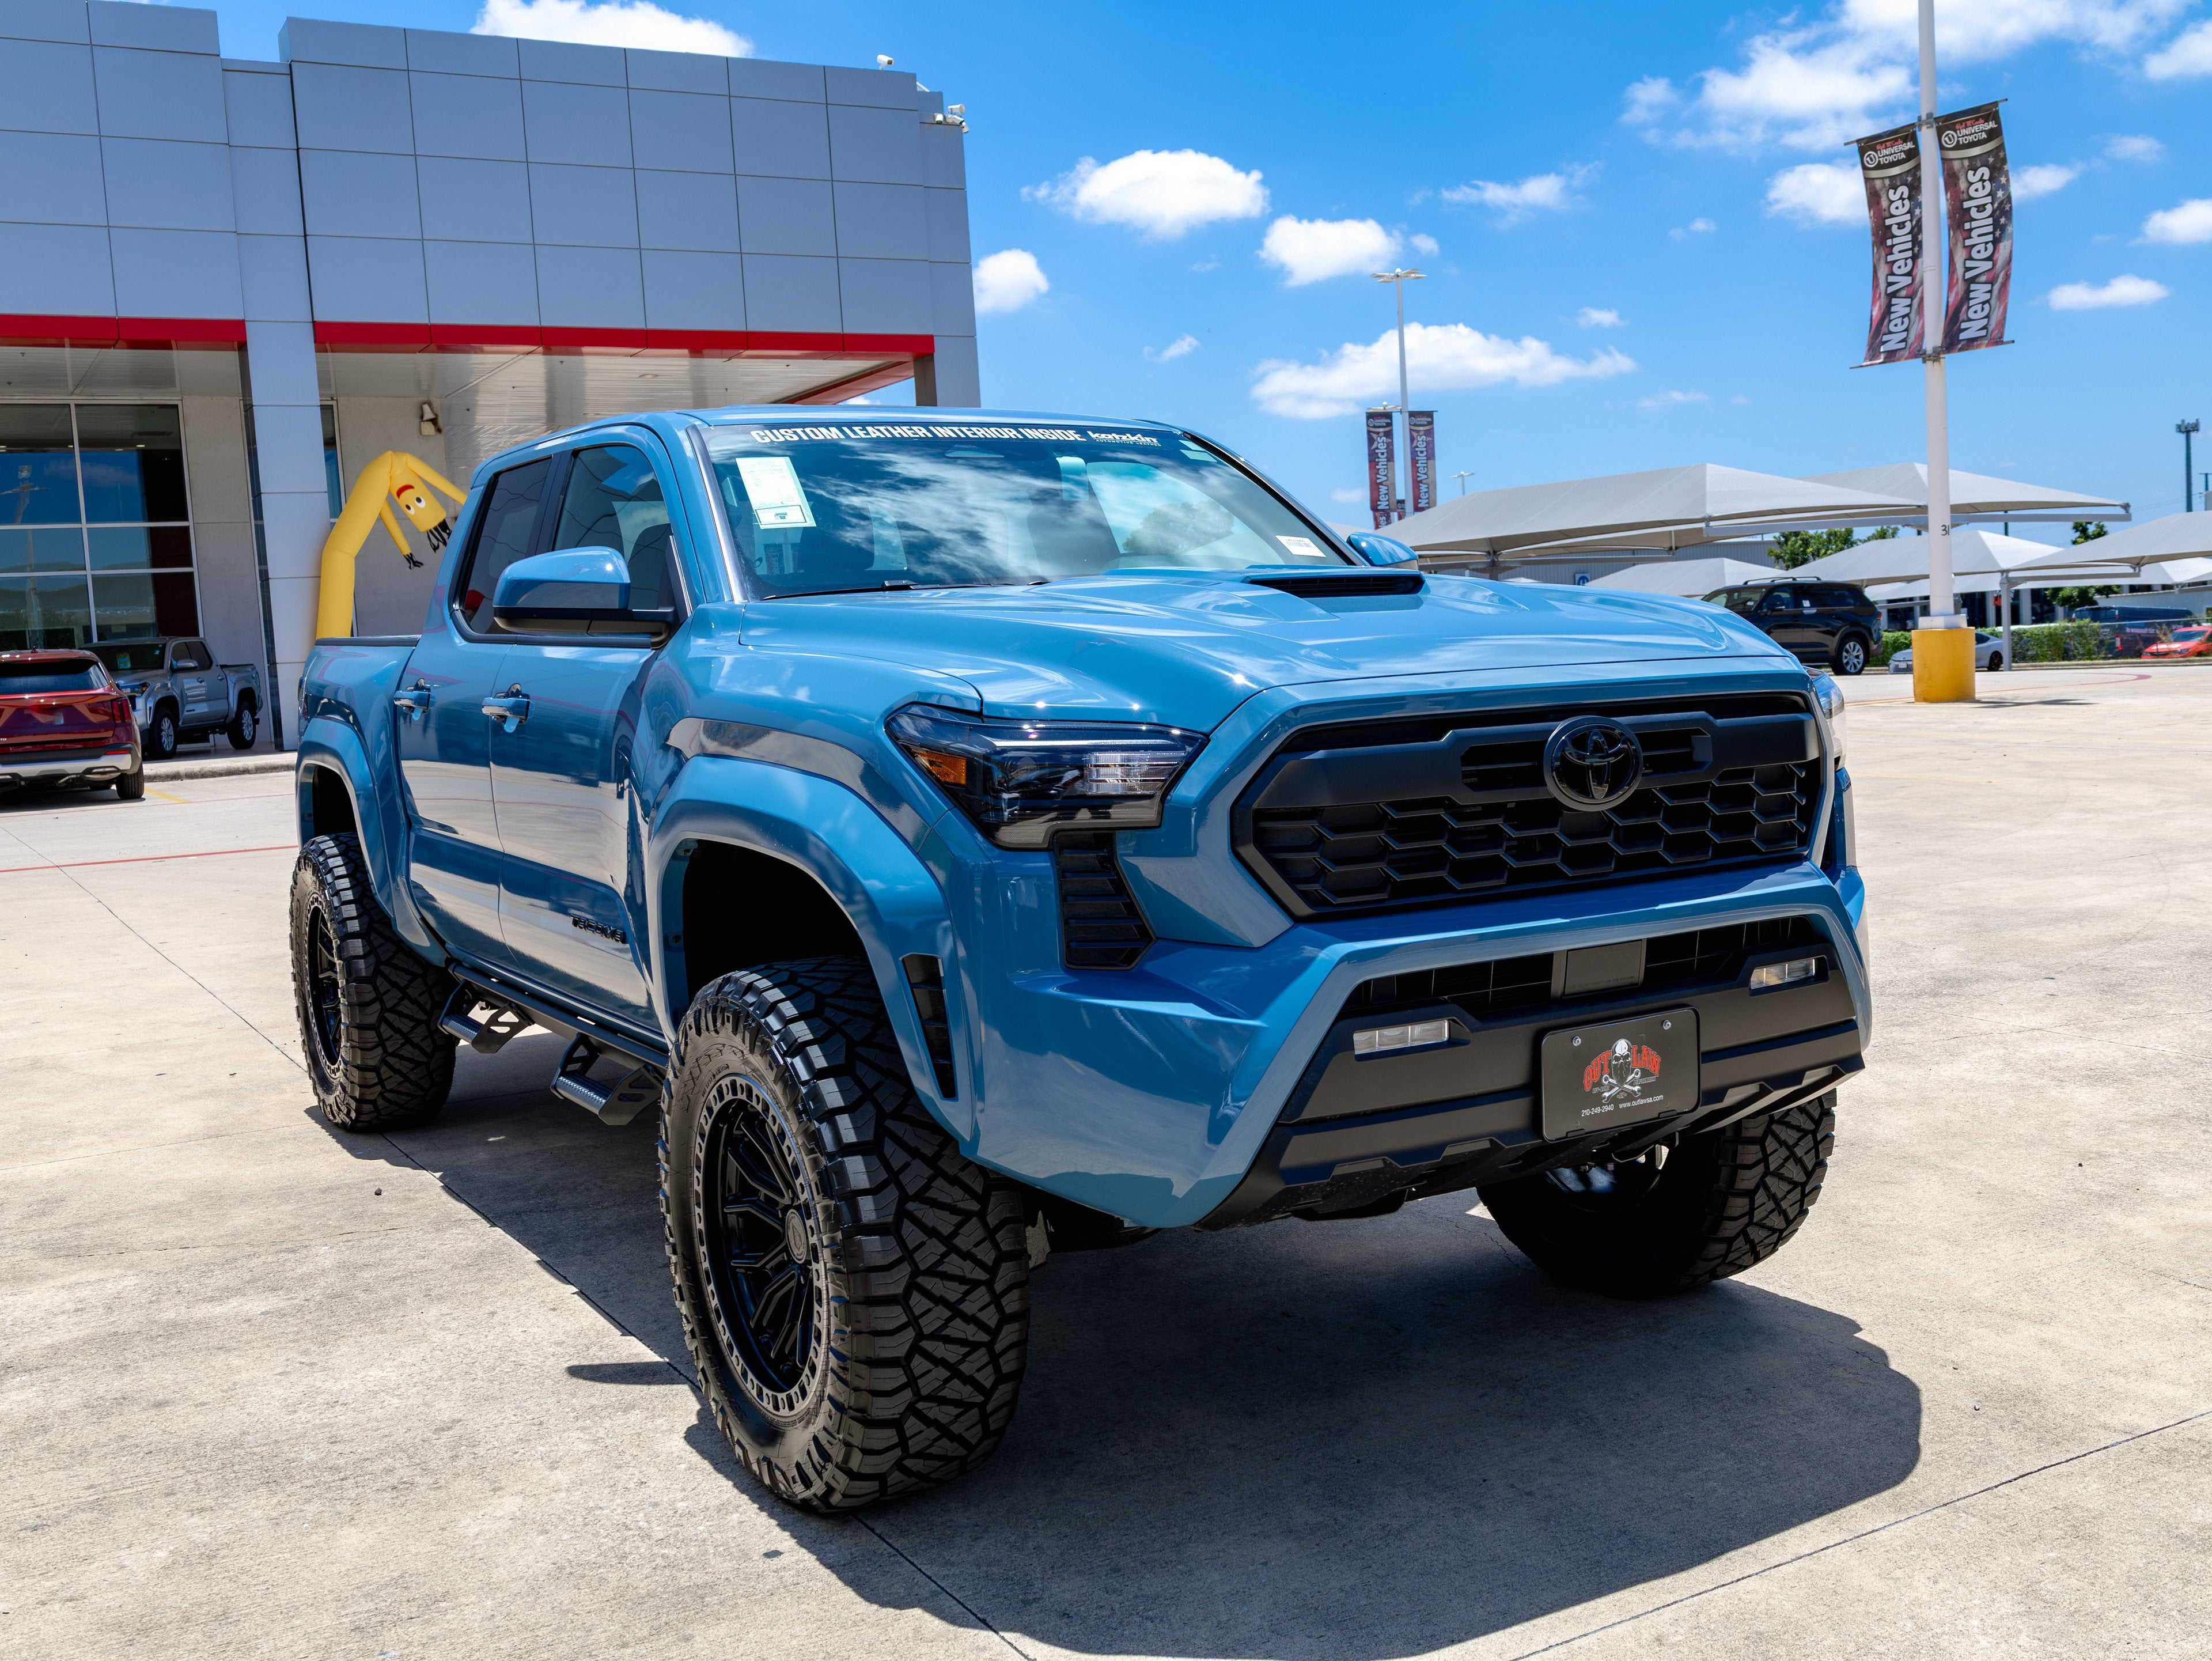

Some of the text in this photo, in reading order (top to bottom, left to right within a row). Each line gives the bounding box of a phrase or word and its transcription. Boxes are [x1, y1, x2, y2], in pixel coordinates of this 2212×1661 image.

[1957, 120, 1998, 137] UNIVERSAL
[1958, 131, 1987, 145] TOYOTA
[1877, 141, 1915, 157] UNIVERSAL
[1878, 152, 1906, 164] TOYOTA
[1960, 166, 1994, 340] New Vehicles
[1880, 186, 1913, 352] New Vehicles
[750, 426, 1086, 443] CUSTOM LEATHER INTERIOR INSIDE
[1375, 436, 1388, 483] Vehicles
[1415, 434, 1429, 508] New Vehicles
[1377, 485, 1389, 510] New
[1941, 524, 1949, 536] 31
[1619, 1095, 1664, 1108] www.outlawsa.com
[1581, 1104, 1614, 1117] 210-249-2940
